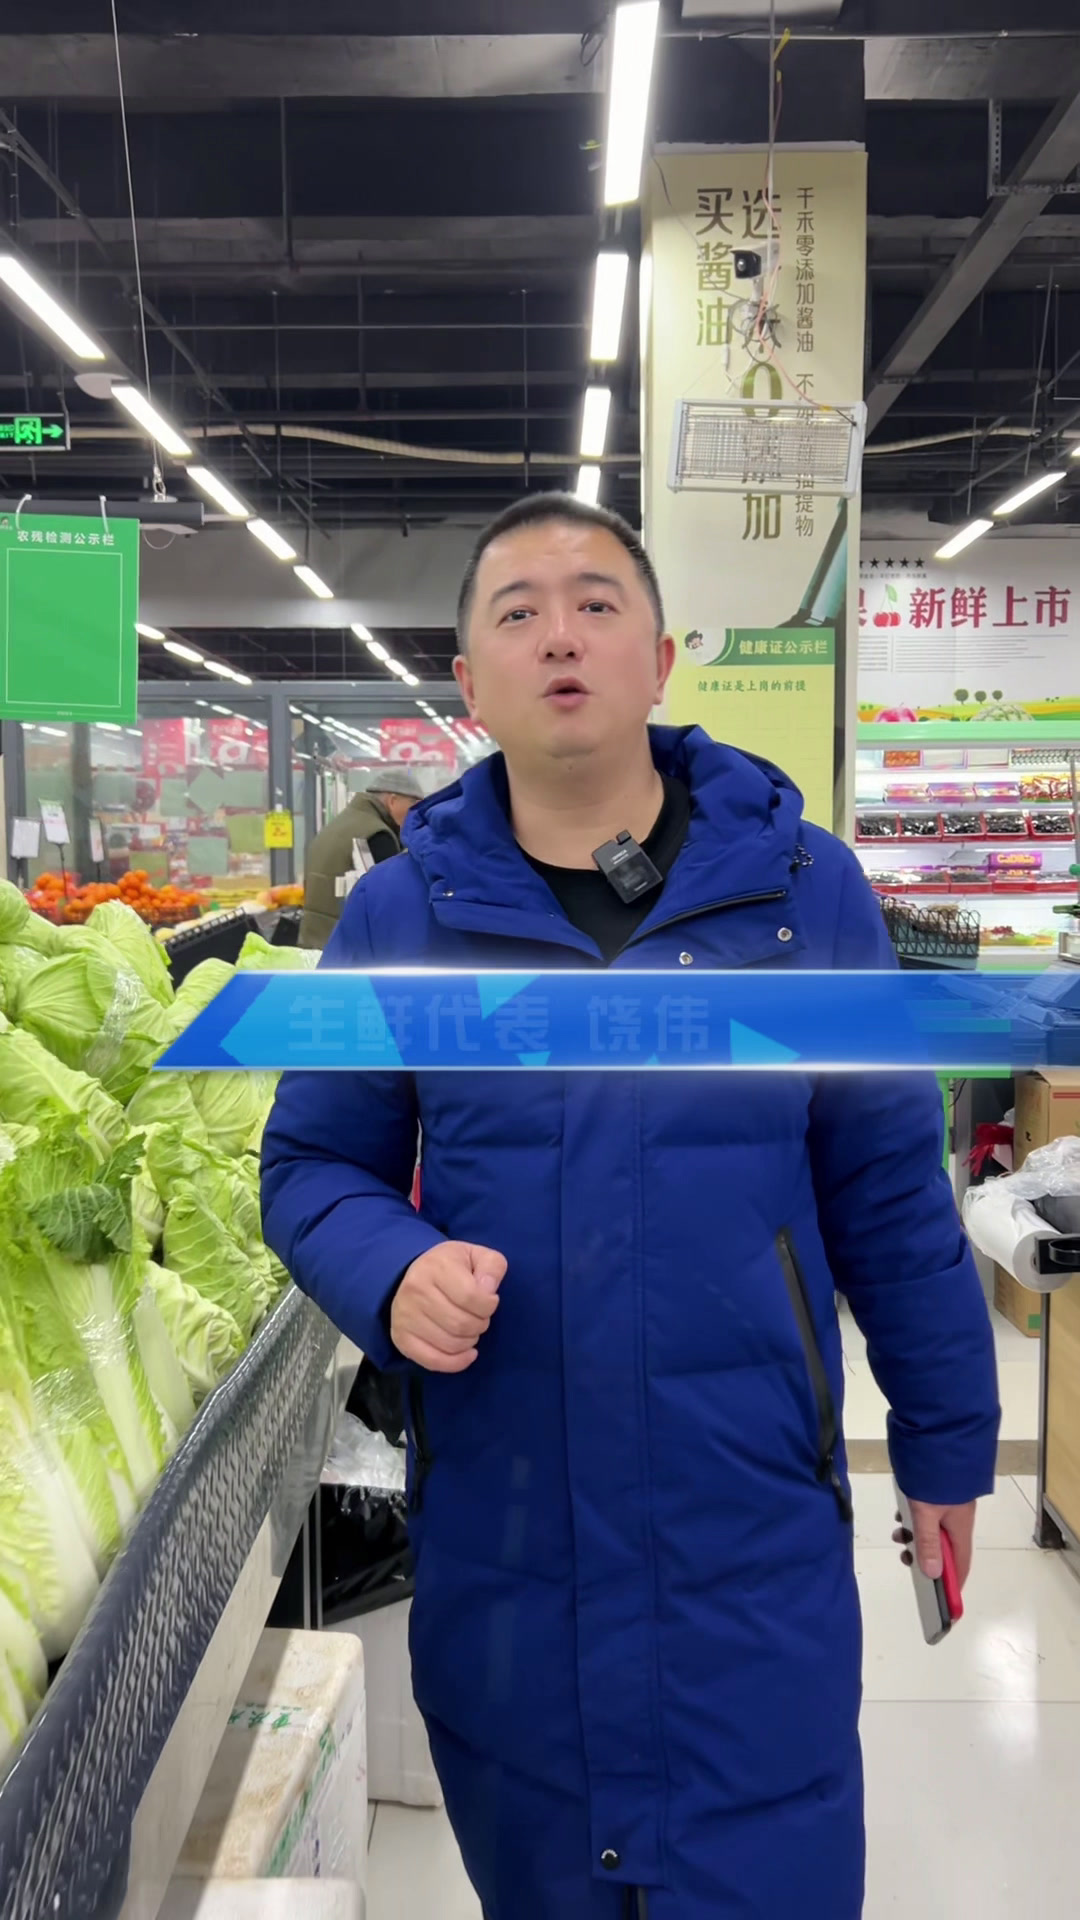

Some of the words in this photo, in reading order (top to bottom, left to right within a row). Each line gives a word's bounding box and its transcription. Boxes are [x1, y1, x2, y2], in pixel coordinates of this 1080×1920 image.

[695, 188, 734, 346] 买酱油
[796, 187, 815, 352] 千禾零添加酱油
[17, 530, 115, 546] 农残检测公示栏
[909, 586, 1071, 629] 新鲜上市
[739, 640, 828, 655] 健康证公示栏
[697, 680, 806, 692] 健康证是上岗的前提
